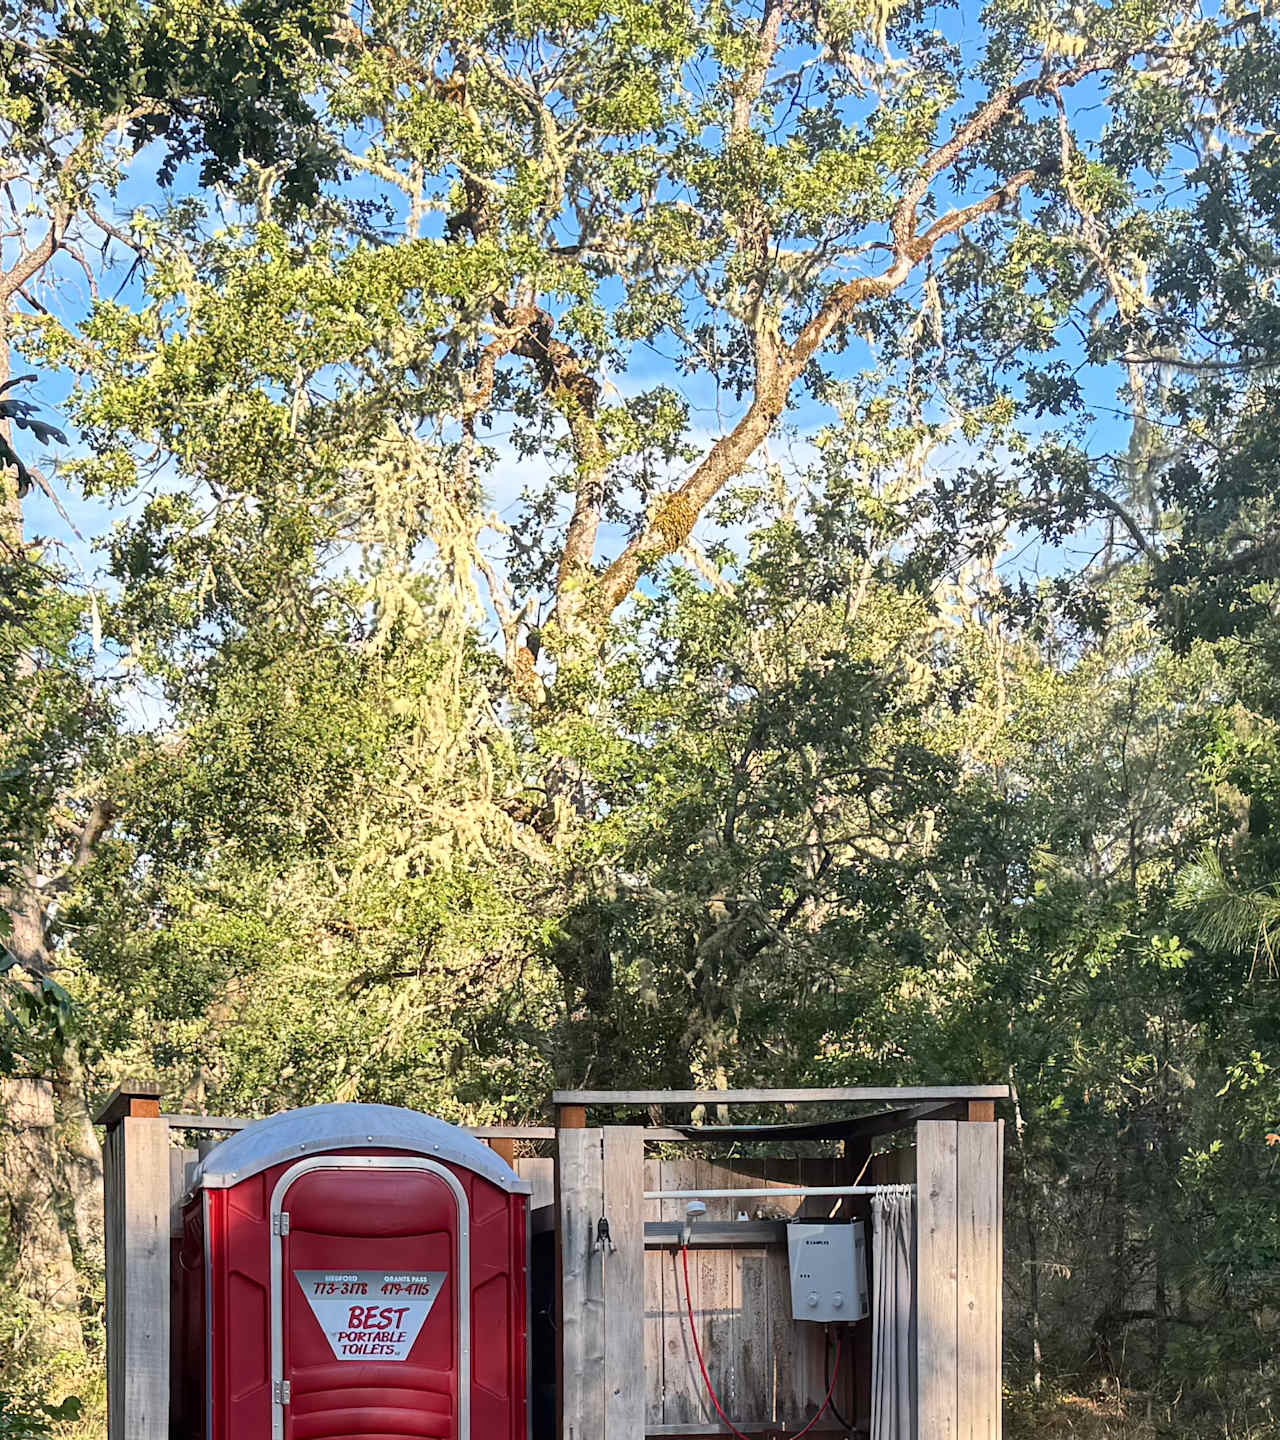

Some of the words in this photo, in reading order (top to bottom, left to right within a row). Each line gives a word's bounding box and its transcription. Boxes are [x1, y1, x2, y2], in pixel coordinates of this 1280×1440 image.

[348, 1305, 410, 1330] BEST
[338, 1331, 407, 1342] PORTABLE
[341, 1344, 394, 1355] TOILETS
